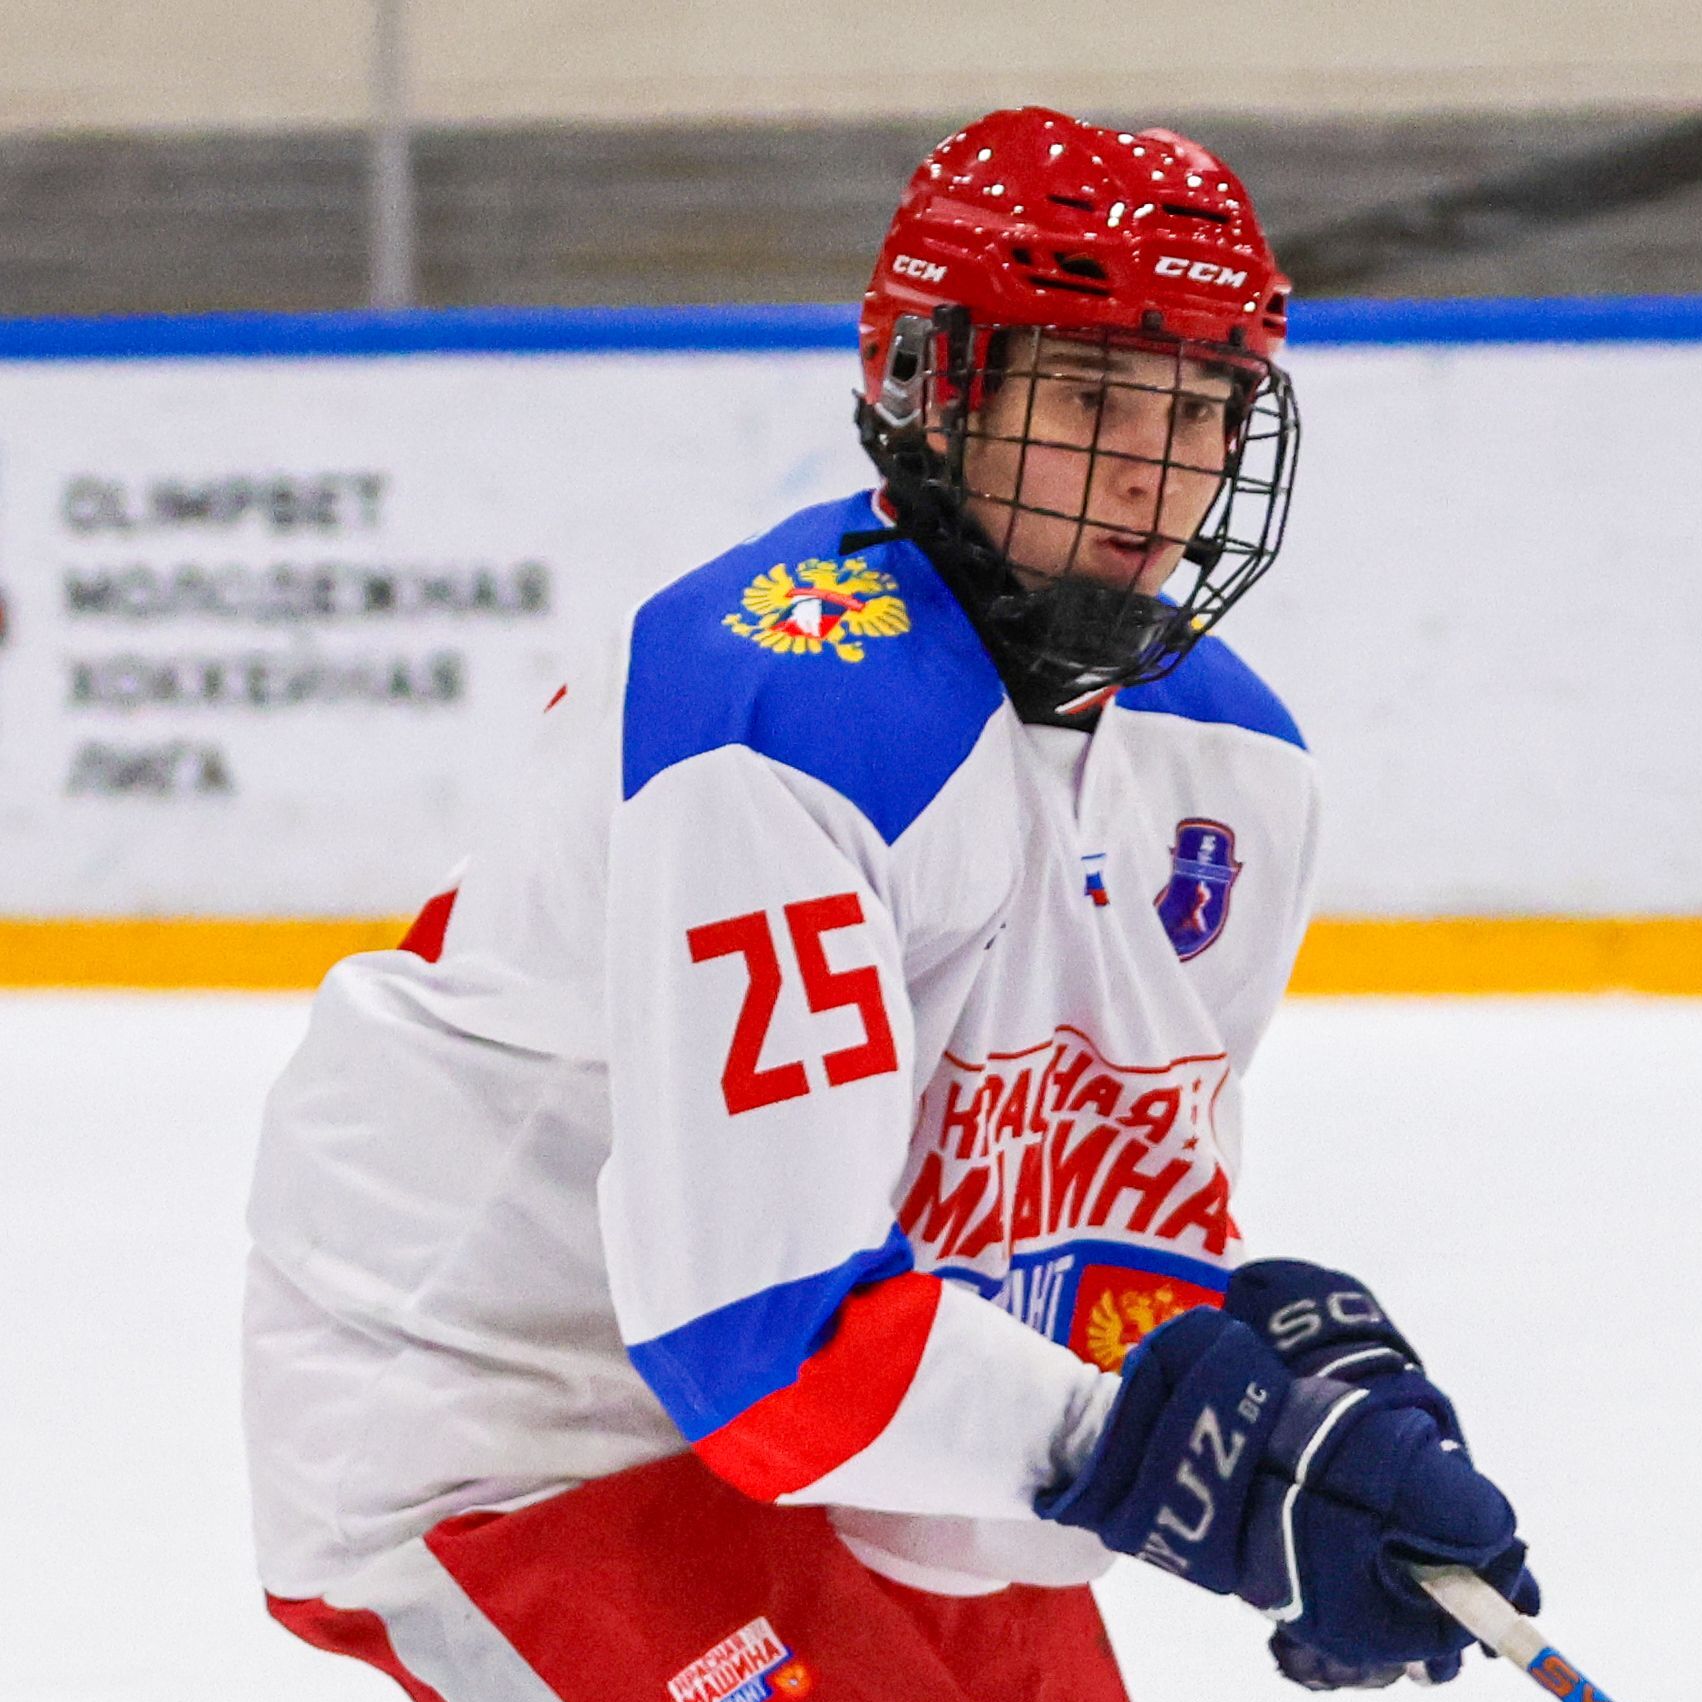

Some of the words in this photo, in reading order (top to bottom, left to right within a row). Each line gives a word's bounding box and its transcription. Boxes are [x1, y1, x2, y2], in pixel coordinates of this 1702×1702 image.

[892, 253, 948, 284] CCM
[1154, 254, 1248, 288] CCM
[686, 891, 898, 1117] 25
